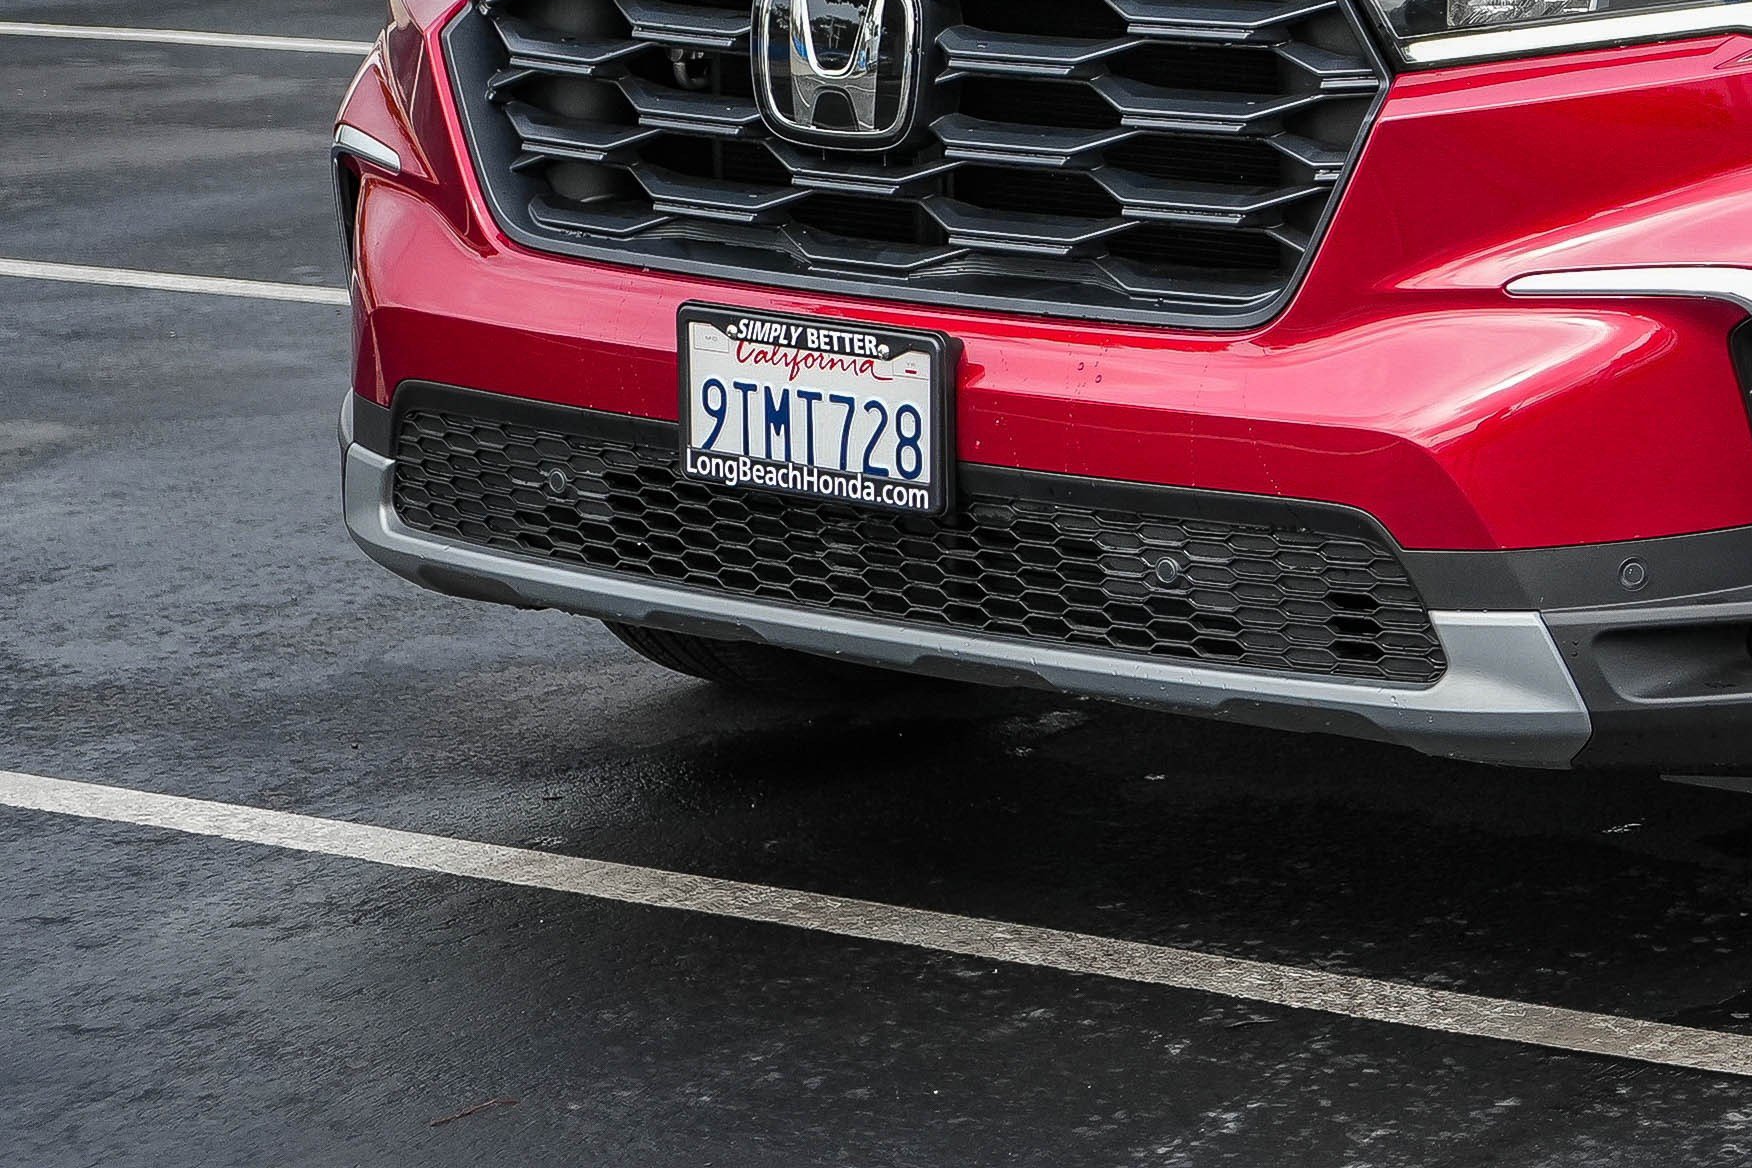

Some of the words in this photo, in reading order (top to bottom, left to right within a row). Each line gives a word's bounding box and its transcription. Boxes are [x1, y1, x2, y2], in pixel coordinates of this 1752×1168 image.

[736, 340, 893, 381] California
[737, 319, 802, 346] SIMPLY
[807, 330, 877, 356] BETTER
[702, 378, 923, 481] 9TMT728
[686, 448, 929, 509] LongBeachHonda.com
